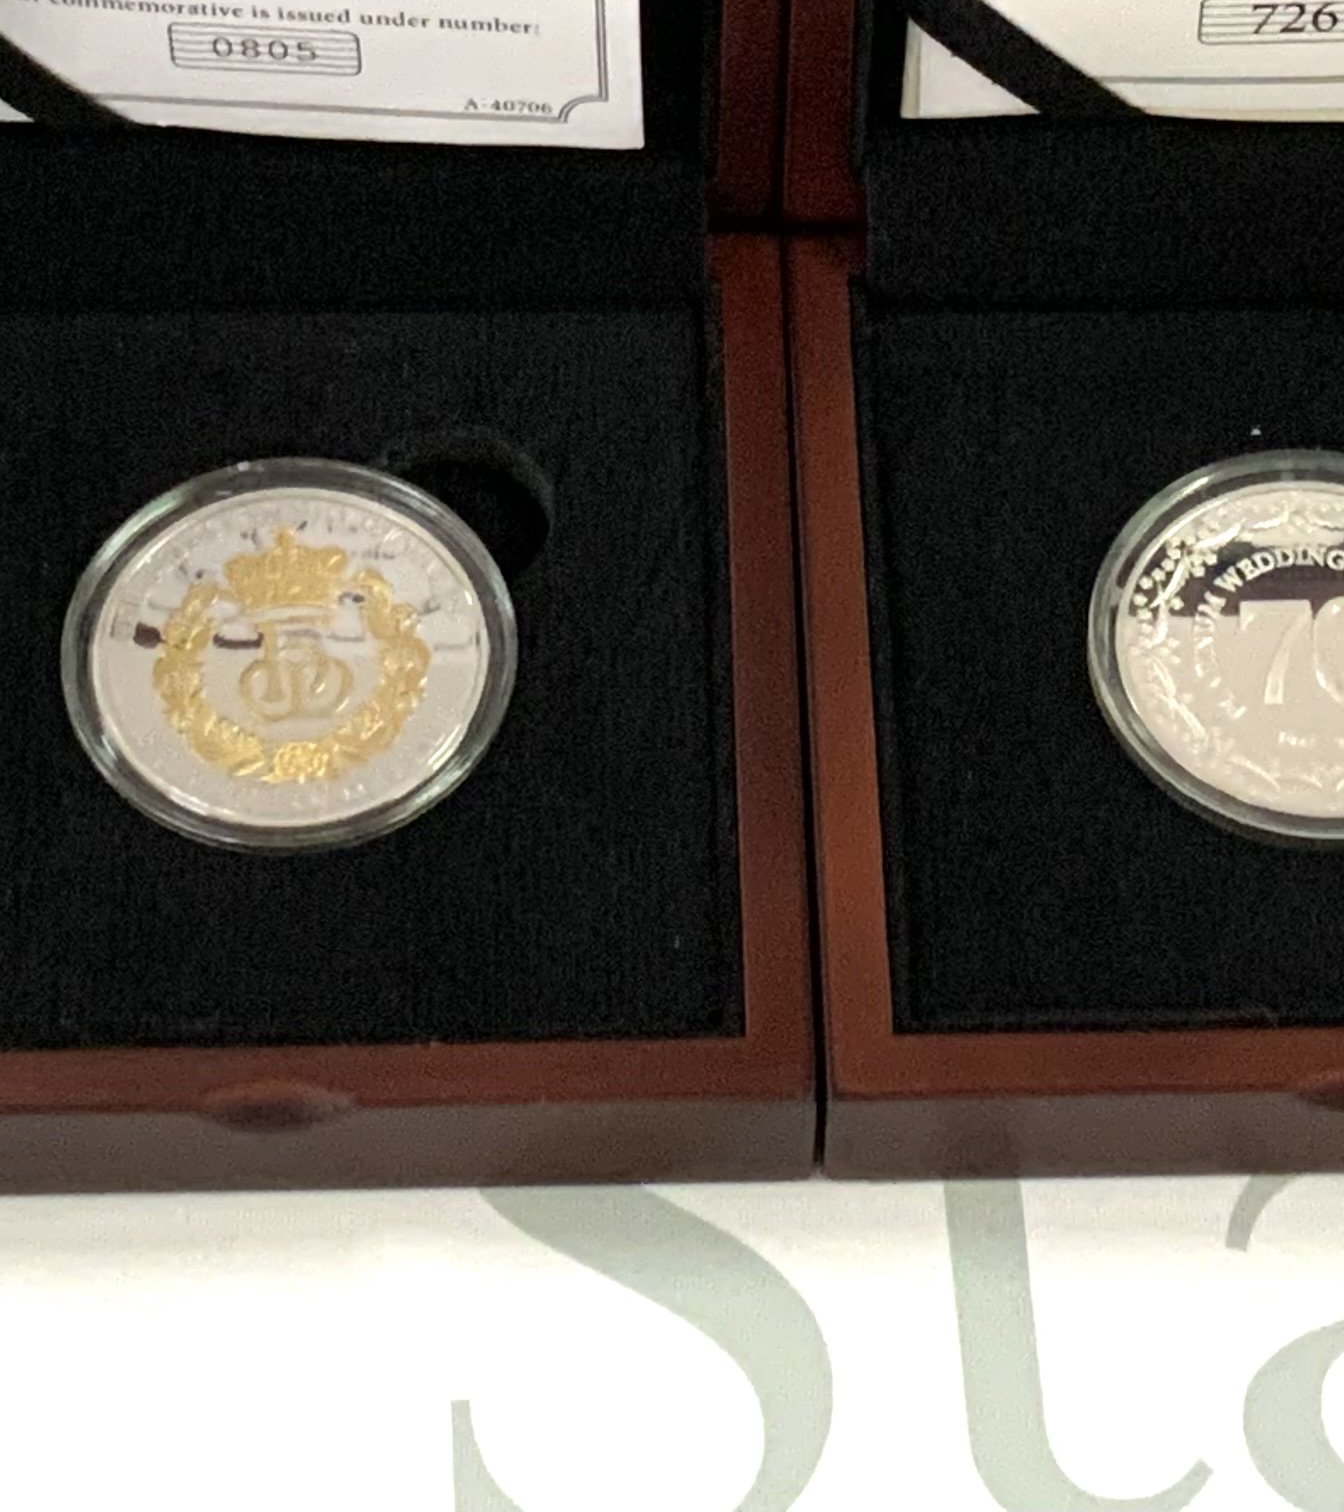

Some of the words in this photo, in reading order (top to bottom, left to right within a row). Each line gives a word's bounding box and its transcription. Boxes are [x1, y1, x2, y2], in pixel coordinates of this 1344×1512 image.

[251, 4, 271, 20] is
[277, 6, 351, 25] issued
[359, 9, 431, 30] under
[439, 14, 541, 36] number:
[1252, 1, 1339, 35] 726
[212, 35, 318, 63] 0805
